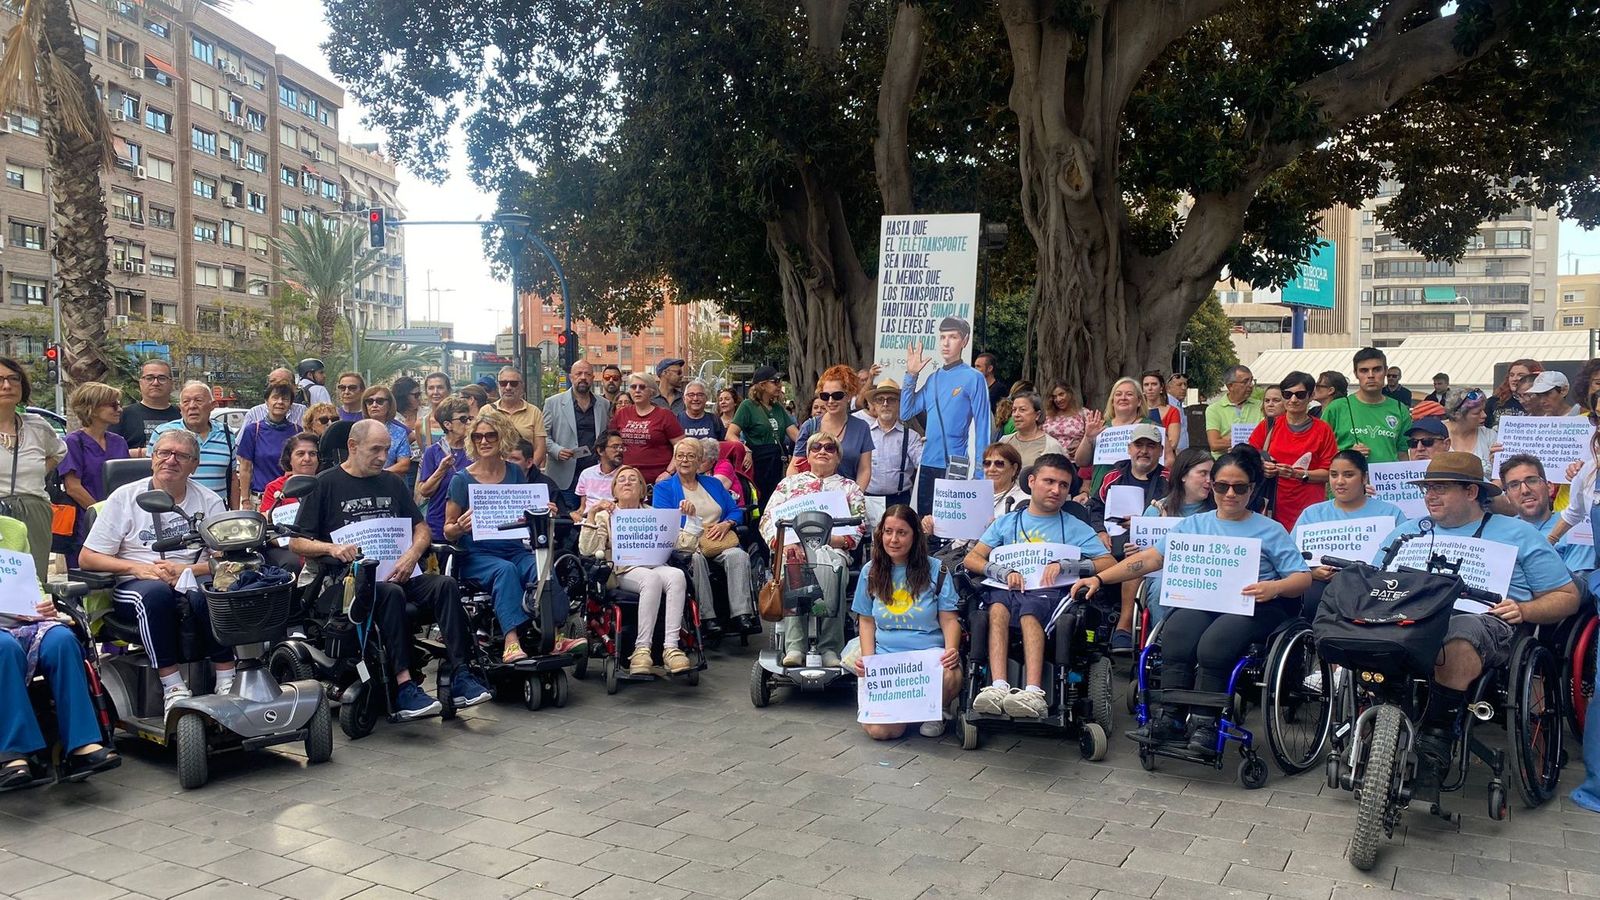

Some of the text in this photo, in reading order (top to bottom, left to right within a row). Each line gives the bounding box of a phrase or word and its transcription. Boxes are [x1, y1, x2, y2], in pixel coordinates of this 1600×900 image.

[886, 220, 928, 236] HASTA QUE
[885, 236, 968, 252] EL TELETRANSPORTE
[884, 254, 898, 268] SEA
[883, 270, 941, 286] AL MENOS QUE
[883, 286, 954, 301] LOS TRANSPORTES
[882, 303, 970, 318] HABITUALES CUMPLAN
[881, 319, 936, 334] LAS LEYES DE
[1101, 429, 1133, 438] Fomenta
[1375, 470, 1425, 480] Necesitam
[1376, 481, 1416, 490] más tax
[1376, 491, 1424, 502] adaptado
[776, 499, 815, 516] Protección
[944, 500, 961, 509] taxis
[616, 515, 656, 523] Protección
[934, 510, 966, 520] adaptados
[356, 528, 386, 536] autobuses
[1136, 525, 1148, 535] La
[1303, 524, 1376, 538] Formación al
[1302, 533, 1350, 546] personal
[1170, 540, 1190, 551] Solo
[1193, 544, 1205, 553] un
[1208, 543, 1230, 555] 18%
[1234, 546, 1247, 556] de
[1302, 542, 1362, 552] transporte
[995, 549, 1053, 562] Fomentar la
[1169, 552, 1240, 567] las estaciones
[1001, 557, 1052, 570] cesibilid
[1168, 563, 1222, 577] de tren son
[1020, 566, 1036, 575] nas
[1166, 577, 1218, 590] accesibles
[1463, 573, 1485, 583] cómo
[866, 661, 923, 677] La movilidad
[867, 674, 930, 689] es un derecho
[868, 687, 926, 702] fundamental.
